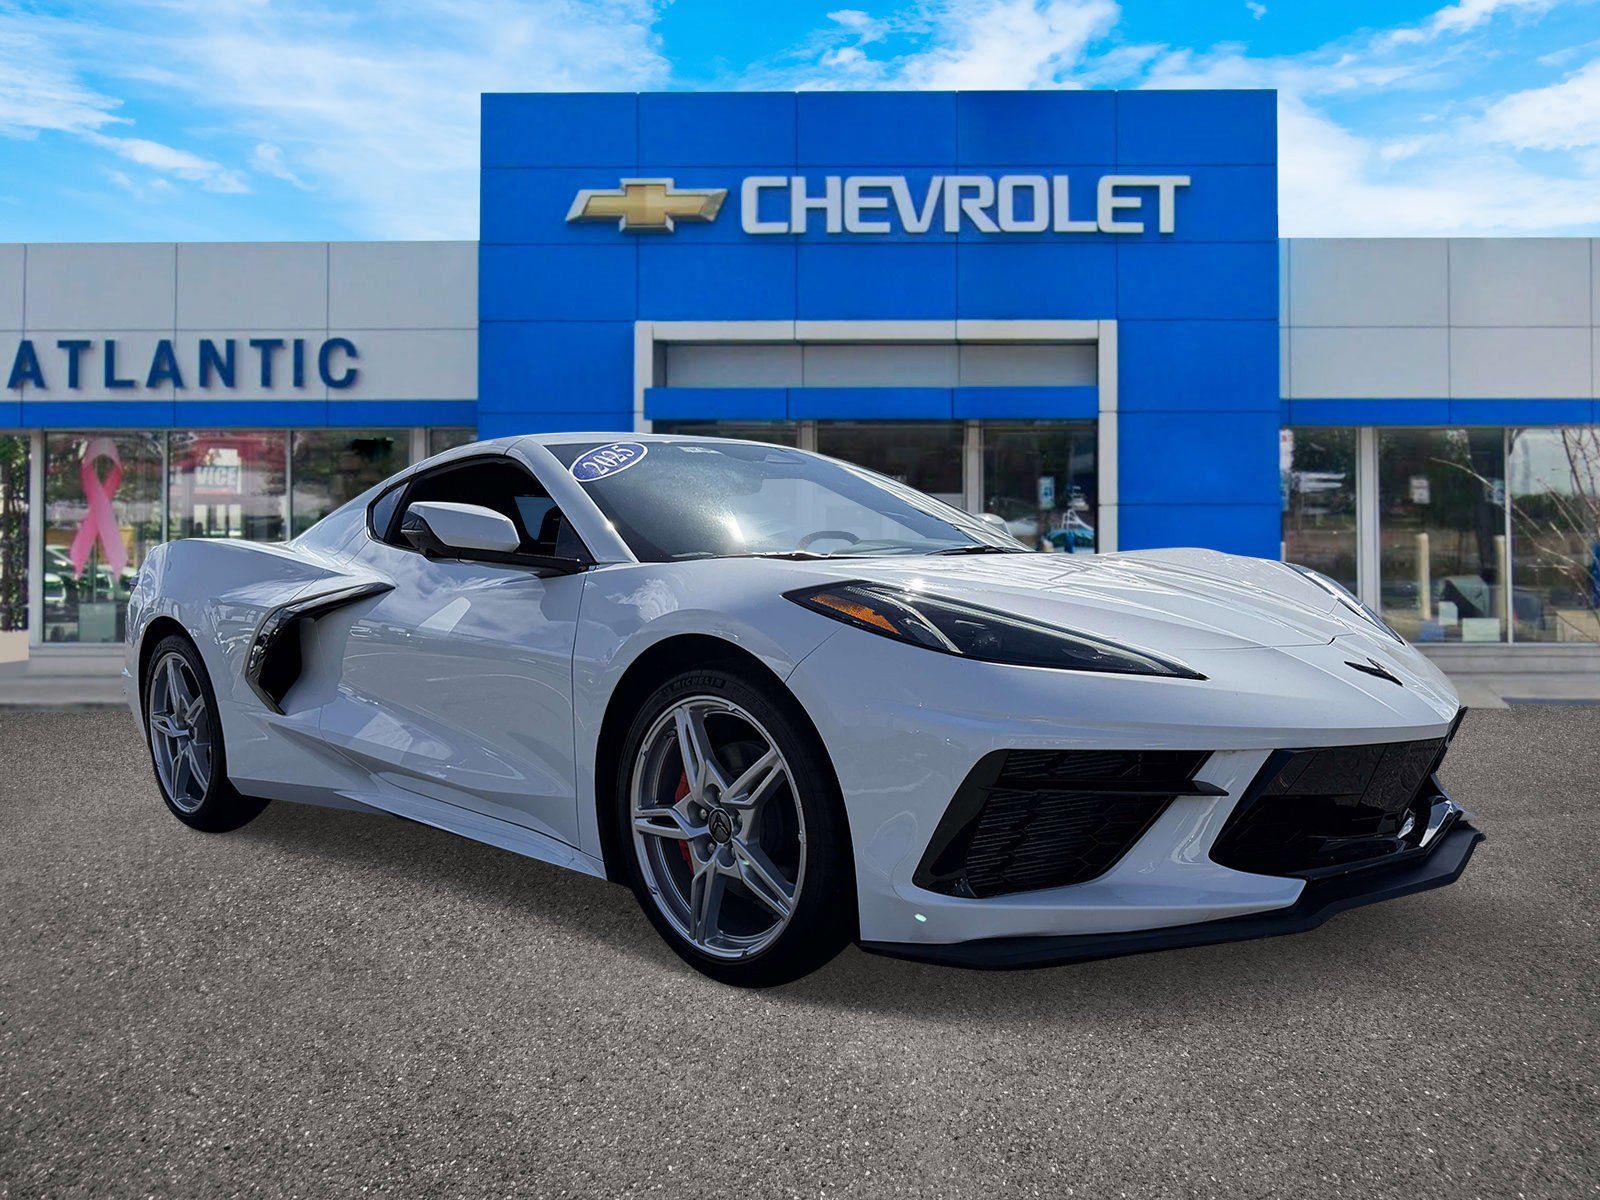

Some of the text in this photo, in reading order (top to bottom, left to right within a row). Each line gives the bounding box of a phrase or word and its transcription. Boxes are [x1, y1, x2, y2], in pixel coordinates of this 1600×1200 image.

[741, 174, 1192, 235] CHEVROLET
[8, 337, 360, 390] ATLANTIC
[582, 446, 635, 475] 2025
